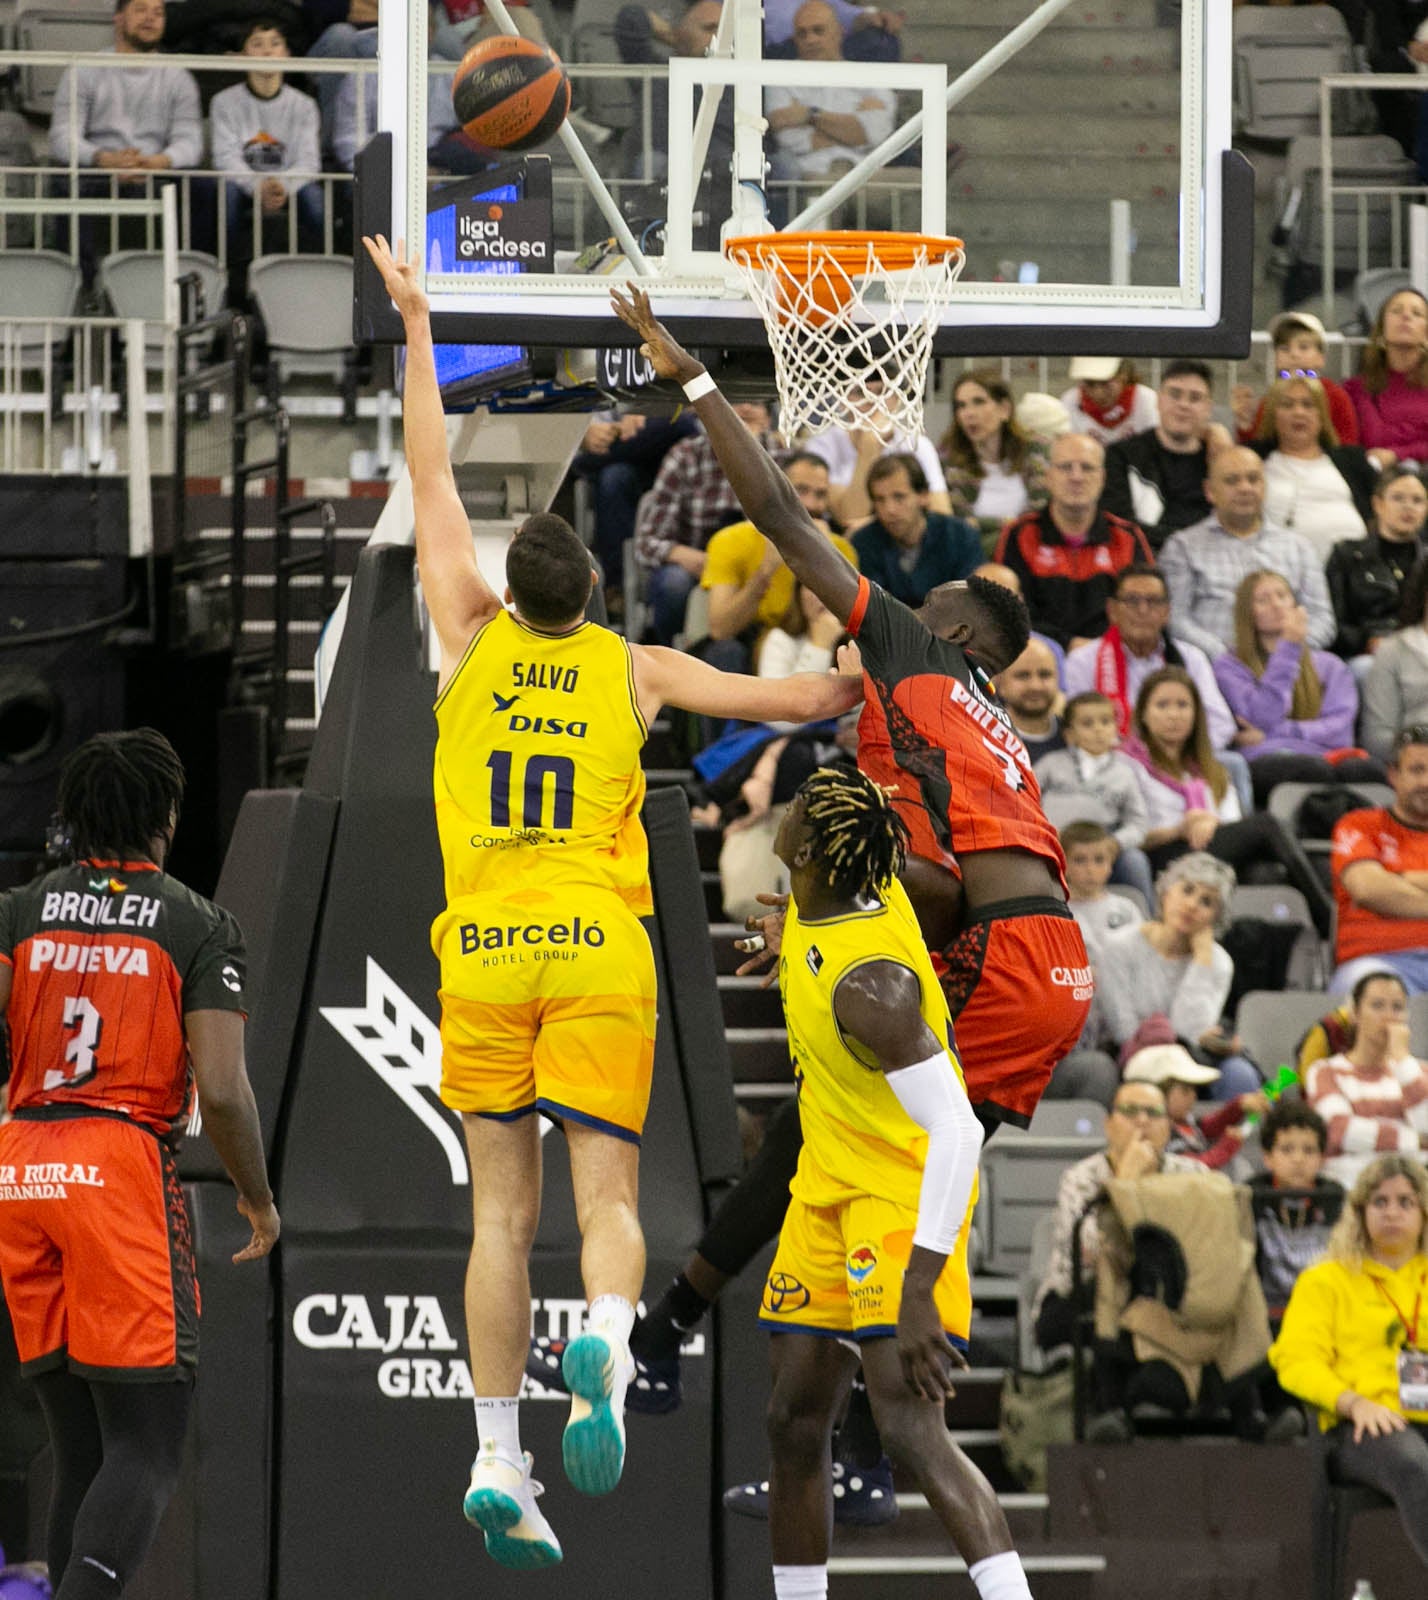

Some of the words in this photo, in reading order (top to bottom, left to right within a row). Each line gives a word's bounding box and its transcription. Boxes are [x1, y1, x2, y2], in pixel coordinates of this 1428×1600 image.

[460, 215, 499, 240] liga
[460, 236, 546, 258] endesa
[512, 662, 580, 694] SALVÓ
[485, 749, 576, 829] 10
[41, 892, 161, 928] BROLEH
[459, 916, 605, 956] Barceló
[482, 953, 526, 968] HOTEL
[534, 950, 579, 962] GROUP
[43, 996, 101, 1091] 3
[23, 1163, 105, 1187] RURAL
[292, 1293, 458, 1354] CAJA
